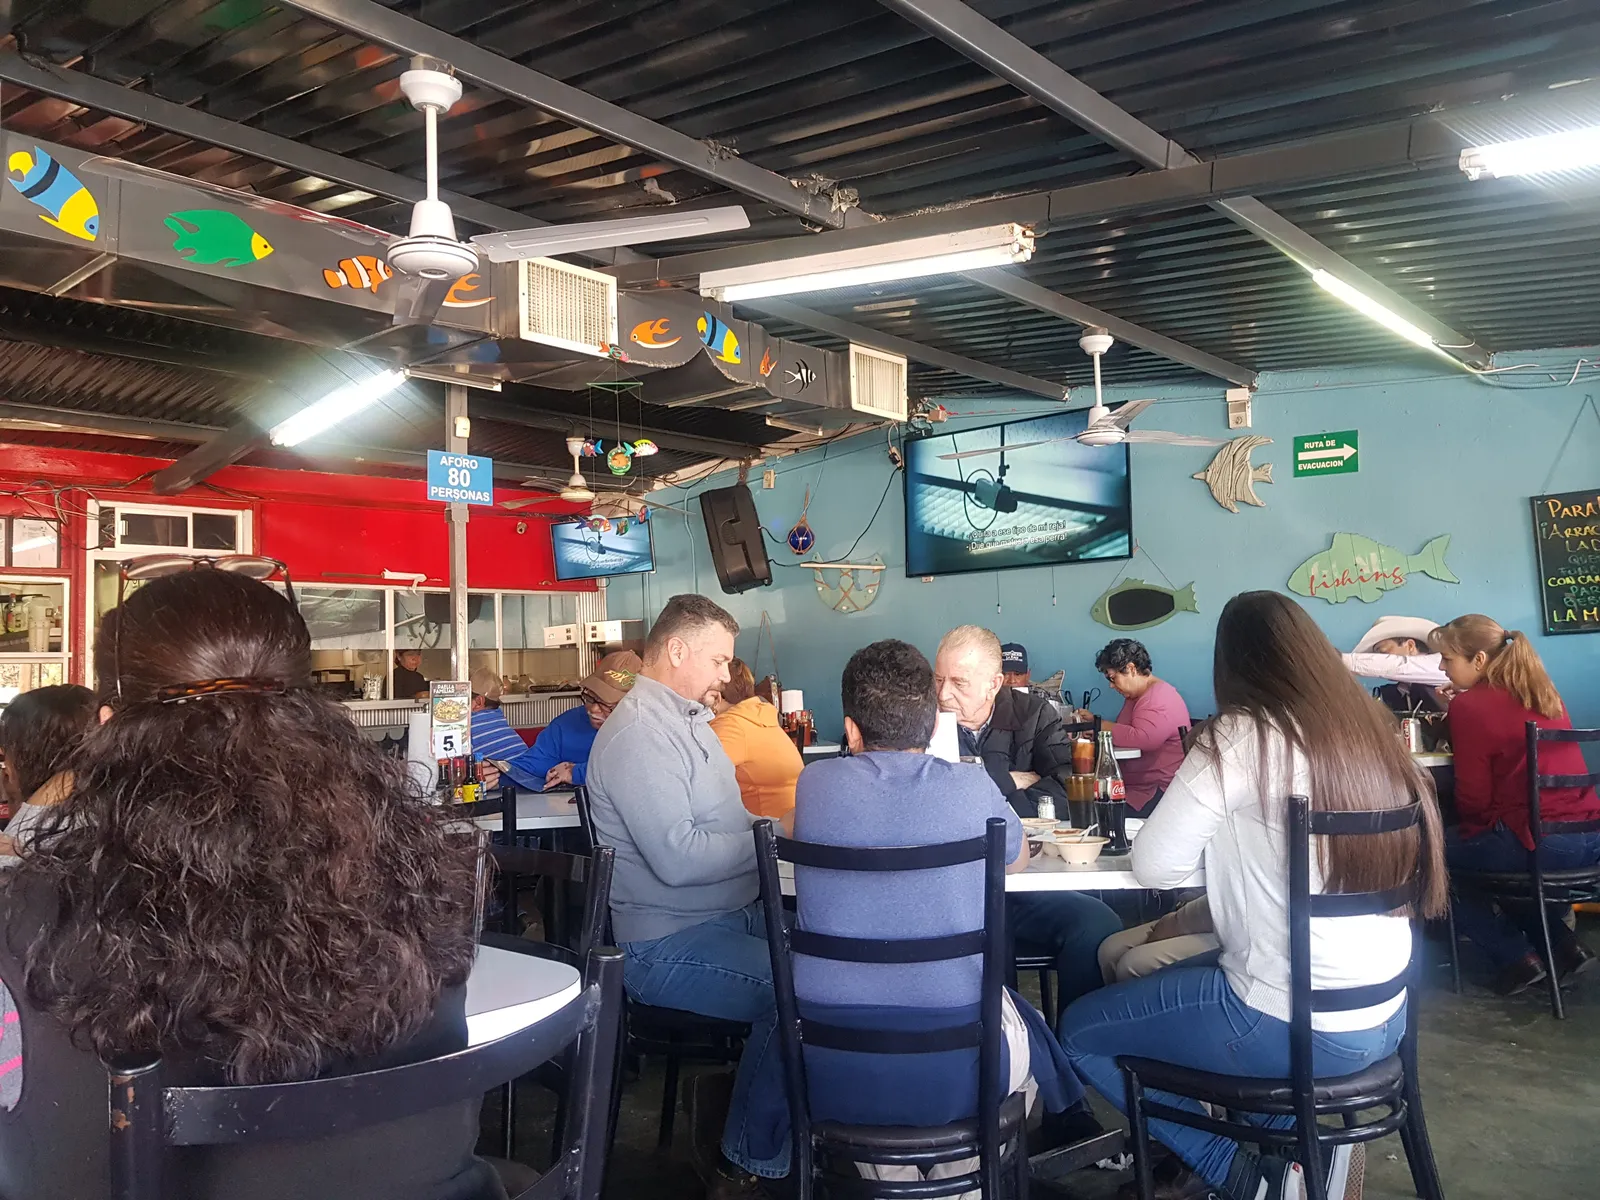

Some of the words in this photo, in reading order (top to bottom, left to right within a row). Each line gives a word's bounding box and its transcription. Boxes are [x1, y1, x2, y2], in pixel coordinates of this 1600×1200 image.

[1304, 441, 1324, 449] RUTA
[1325, 439, 1336, 447] DE
[440, 456, 478, 469] AFORO
[1298, 460, 1343, 470] EVACUACION
[448, 468, 470, 487] 80
[431, 486, 490, 502] PERSONAS
[1027, 523, 1037, 533] de
[1038, 522, 1048, 531] mi
[1309, 567, 1403, 596] fishing
[1548, 576, 1575, 587] CON
[1553, 609, 1577, 622] LA
[443, 735, 454, 751] 5
